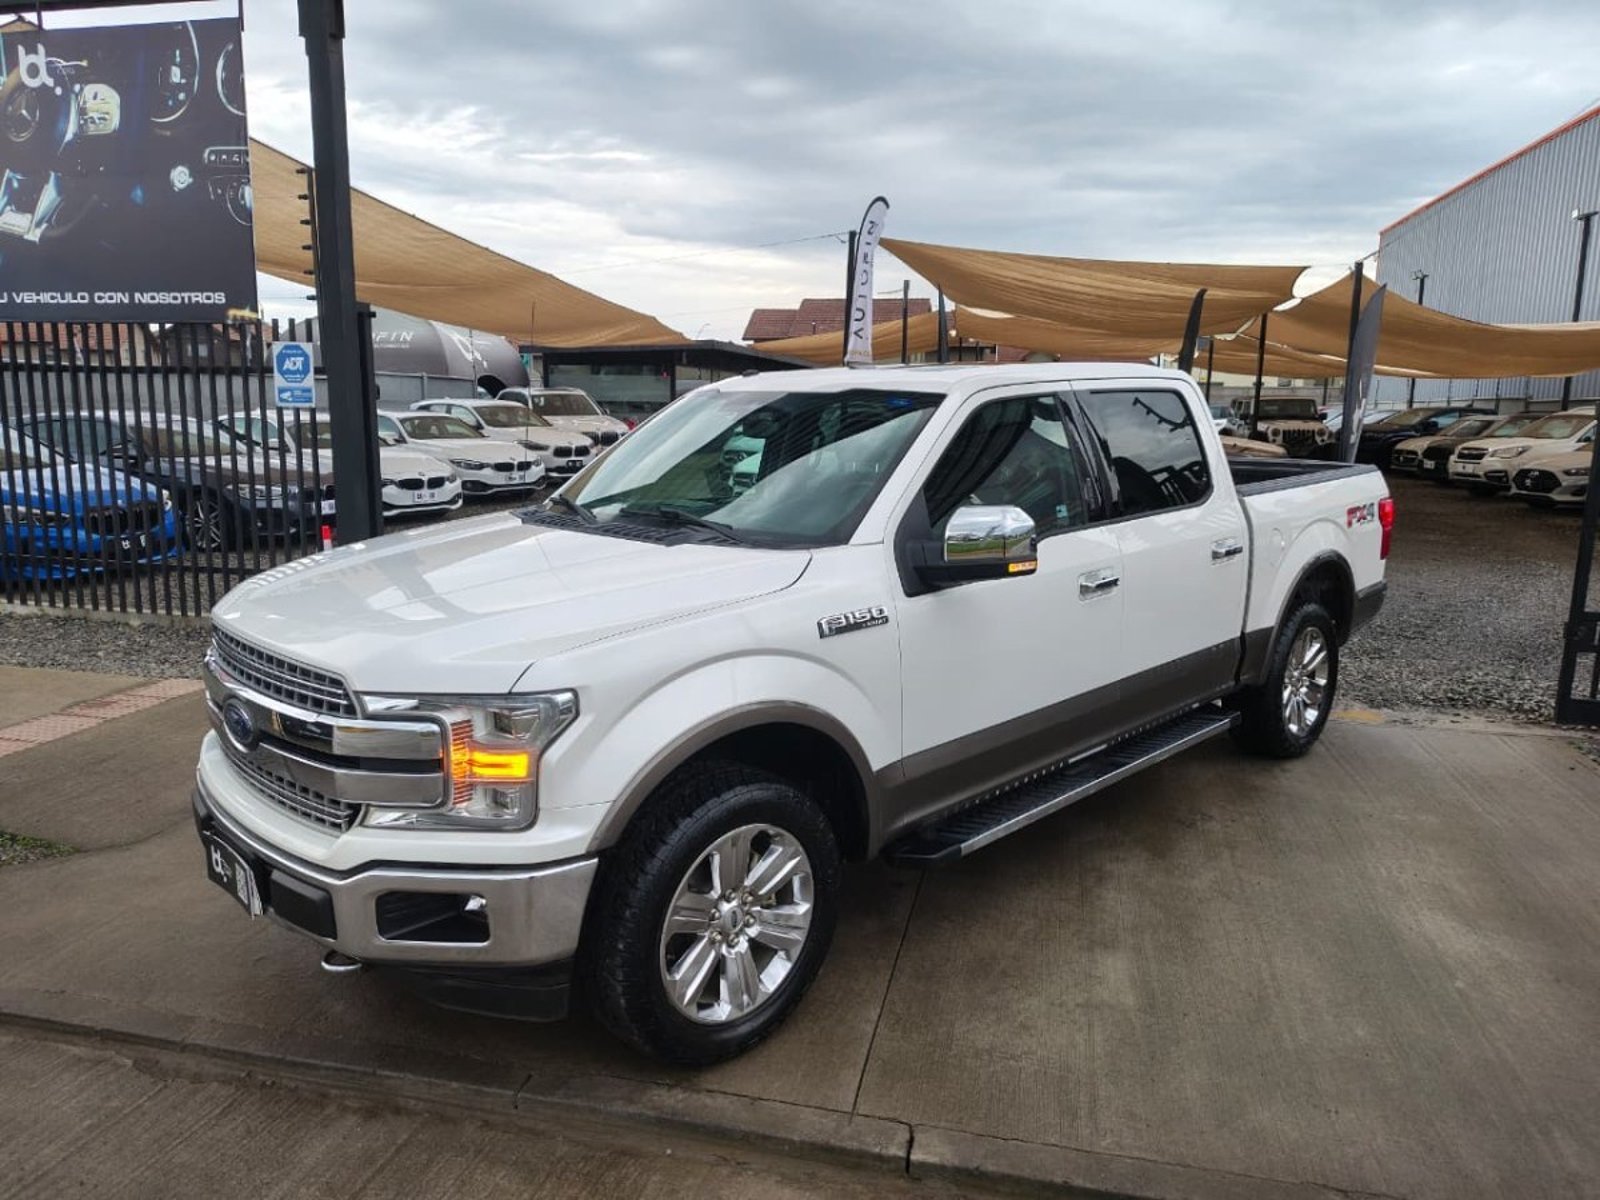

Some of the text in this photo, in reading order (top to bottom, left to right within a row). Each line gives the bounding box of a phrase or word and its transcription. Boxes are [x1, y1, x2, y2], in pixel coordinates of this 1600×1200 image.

[12, 291, 89, 304] VEHICULO
[93, 291, 129, 304] CON
[134, 291, 226, 304] NOSOTROS
[372, 331, 415, 342] FIN
[282, 356, 304, 370] ADT
[1346, 502, 1375, 528] FX4
